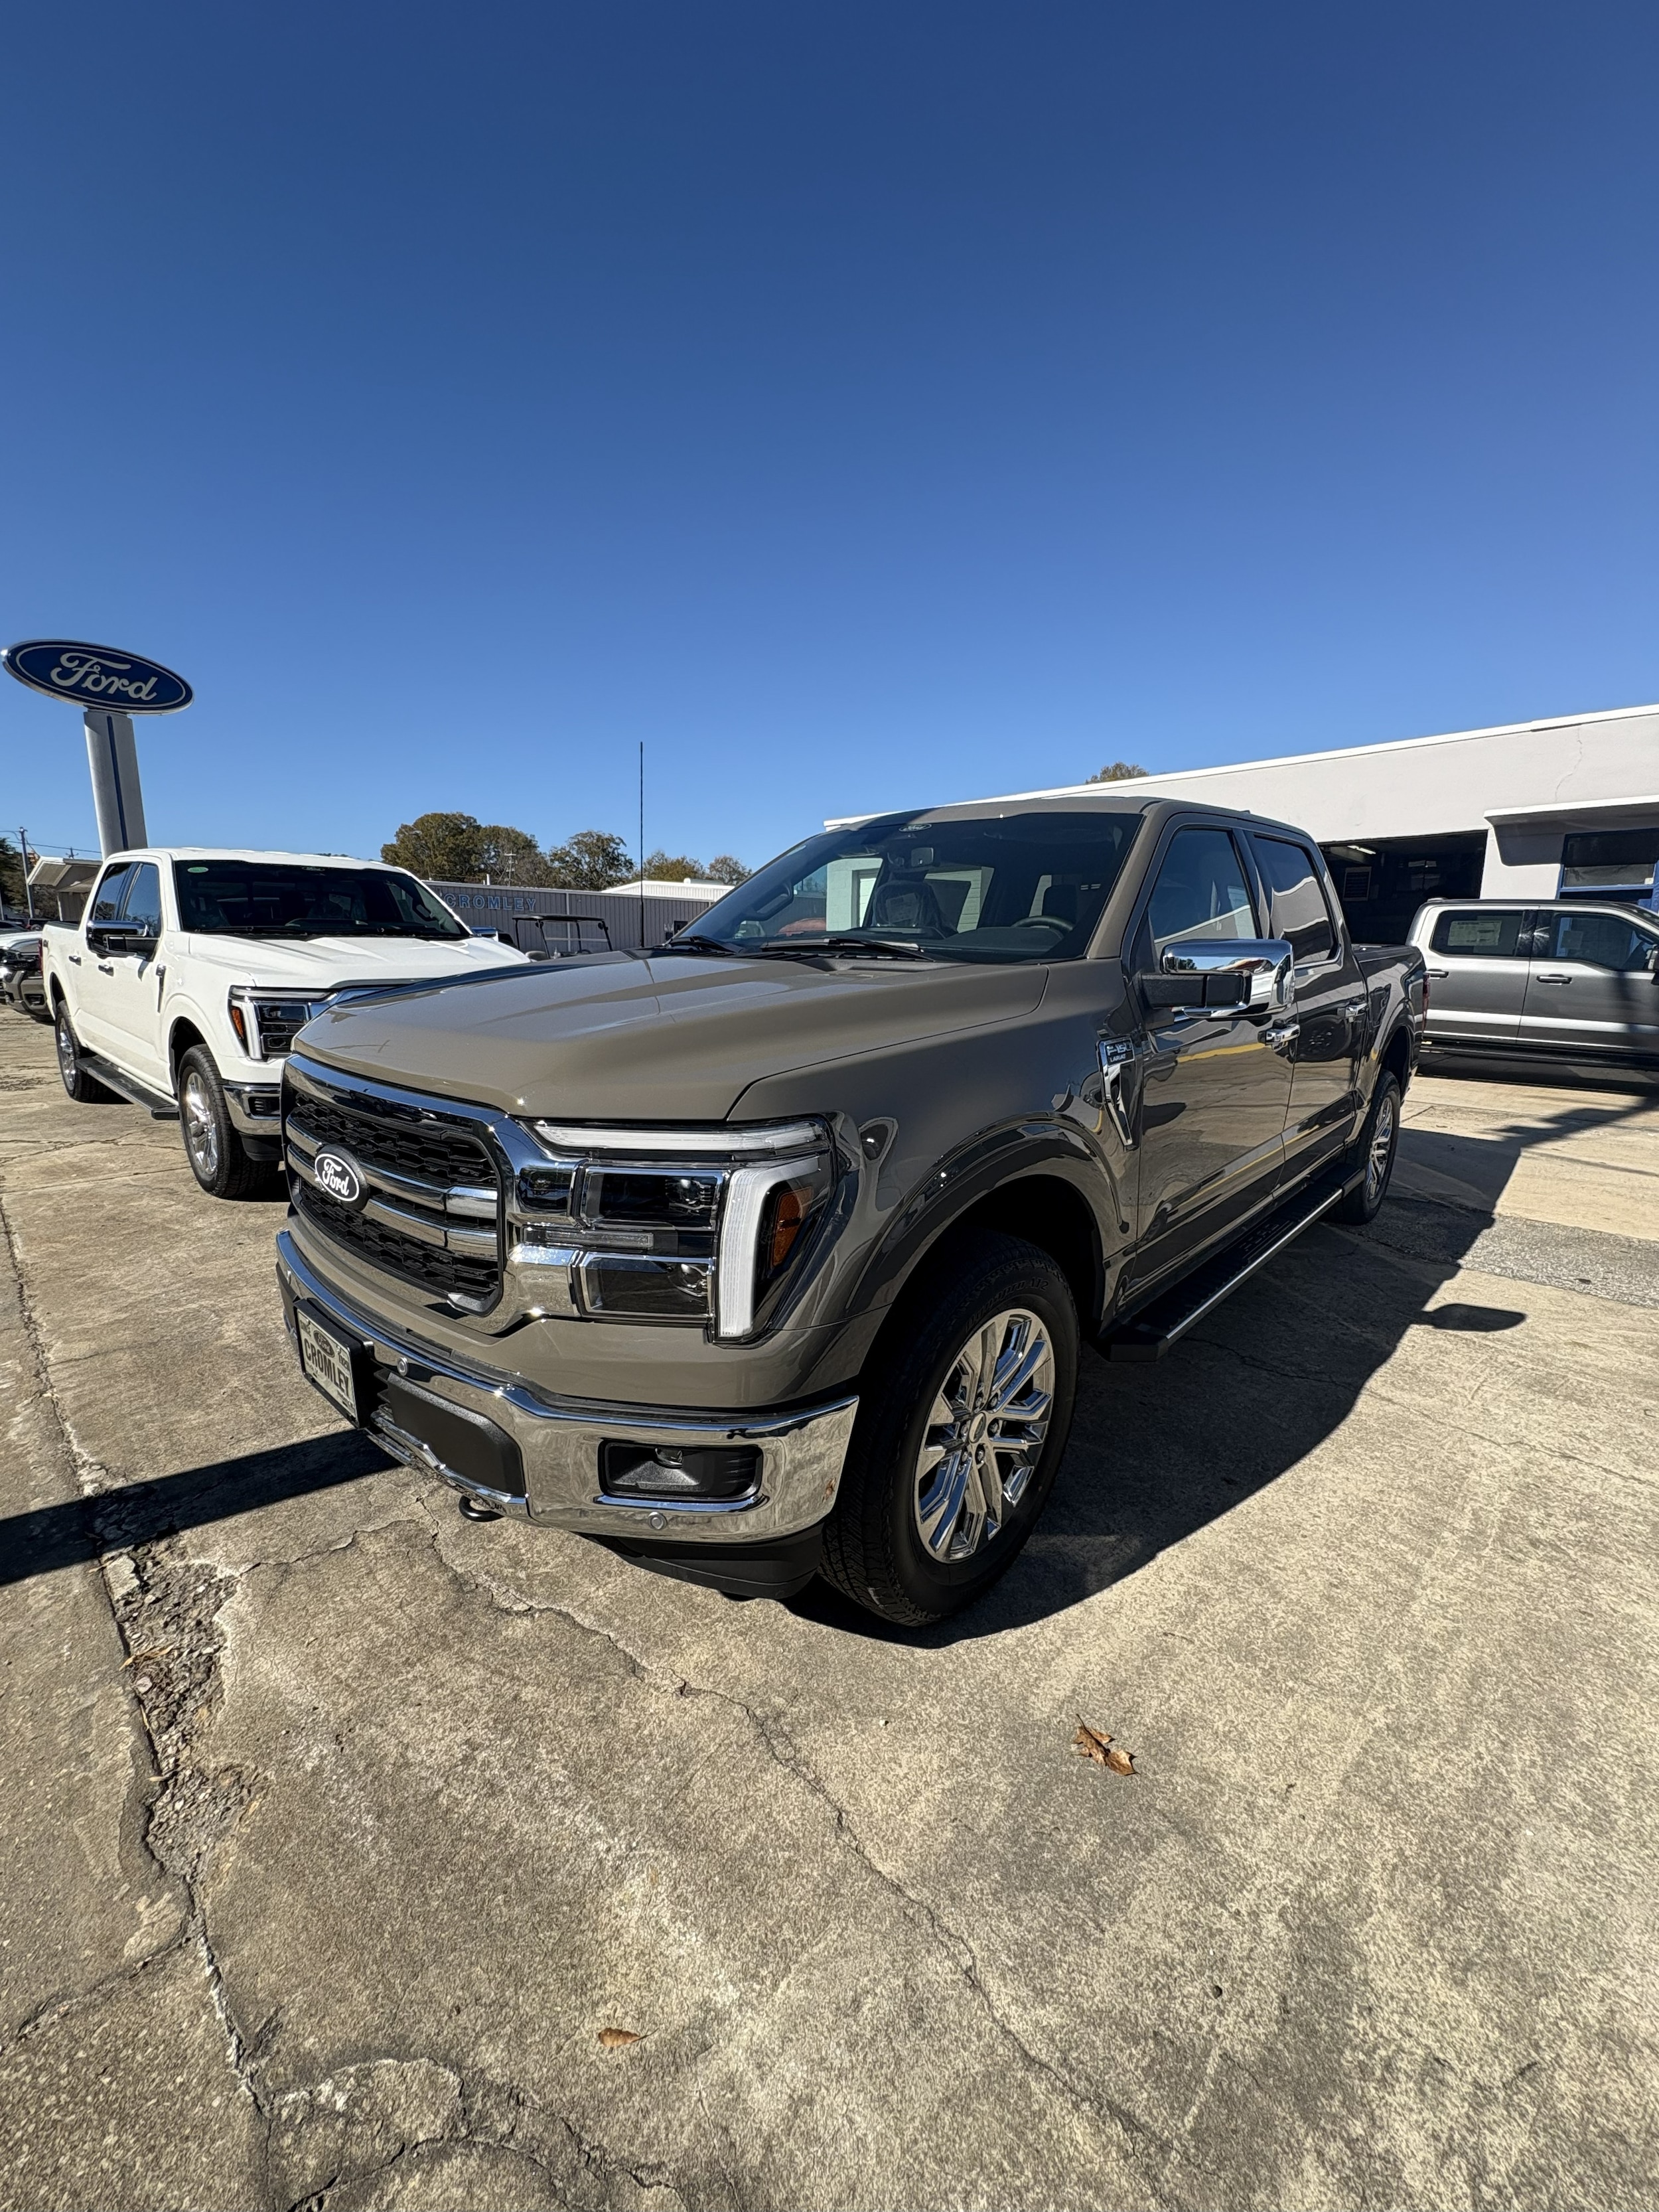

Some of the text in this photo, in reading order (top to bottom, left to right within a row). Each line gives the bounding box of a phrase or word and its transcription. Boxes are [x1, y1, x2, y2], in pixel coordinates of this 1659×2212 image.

[50, 652, 158, 701] Ford
[443, 893, 536, 912] CROMLEY
[1106, 1042, 1132, 1056] F-150
[1110, 1053, 1126, 1063] LARIAT
[322, 1158, 350, 1196] Ford
[318, 1333, 332, 1355] Ford
[303, 1337, 350, 1398] CROMLEY
